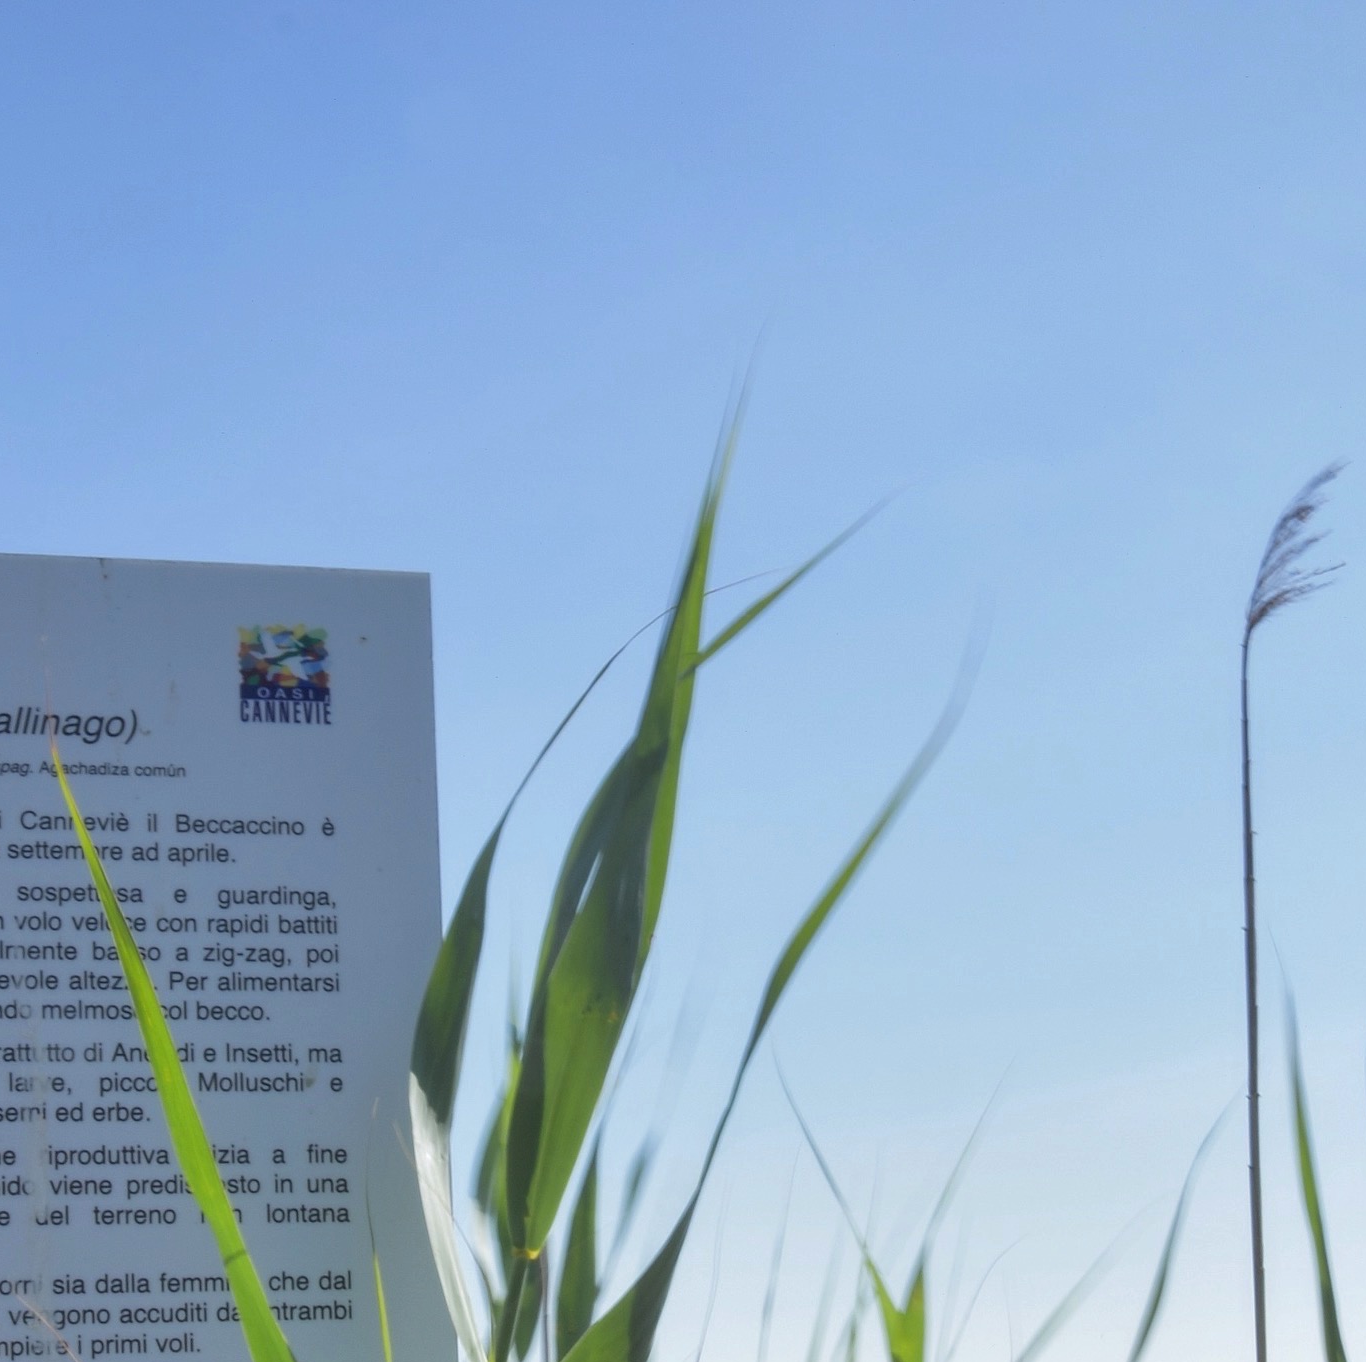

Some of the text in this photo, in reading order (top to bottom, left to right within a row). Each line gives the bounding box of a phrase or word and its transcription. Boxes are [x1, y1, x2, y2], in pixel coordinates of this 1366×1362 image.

[257, 687, 314, 699] OASI
[176, 814, 305, 836] Beccaccino
[168, 844, 235, 866] aprile.
[218, 886, 336, 911] guardinga,
[14, 911, 62, 931] volo
[156, 917, 197, 933] con
[208, 915, 268, 938] rapidi
[279, 915, 337, 934] battiti
[203, 943, 291, 968] zig-zag,
[307, 944, 339, 967] poi
[169, 971, 208, 991] Per
[218, 972, 339, 992] alimentarsi
[196, 1001, 270, 1021] becco.
[226, 1043, 299, 1065] Insetti,
[198, 1072, 306, 1092] Molluschi
[92, 1102, 150, 1122] erbe.
[307, 1144, 347, 1164] fine
[50, 1175, 112, 1195] viene
[307, 1178, 349, 1193] una
[93, 1206, 176, 1225] terreno
[267, 1204, 350, 1223] lontana
[53, 1275, 86, 1295] sia
[95, 1273, 150, 1294] dalla
[268, 1271, 309, 1291] che
[319, 1271, 351, 1290] dal
[120, 1303, 207, 1324] accuditi
[91, 1334, 147, 1359] primi
[155, 1333, 200, 1353] voli.
